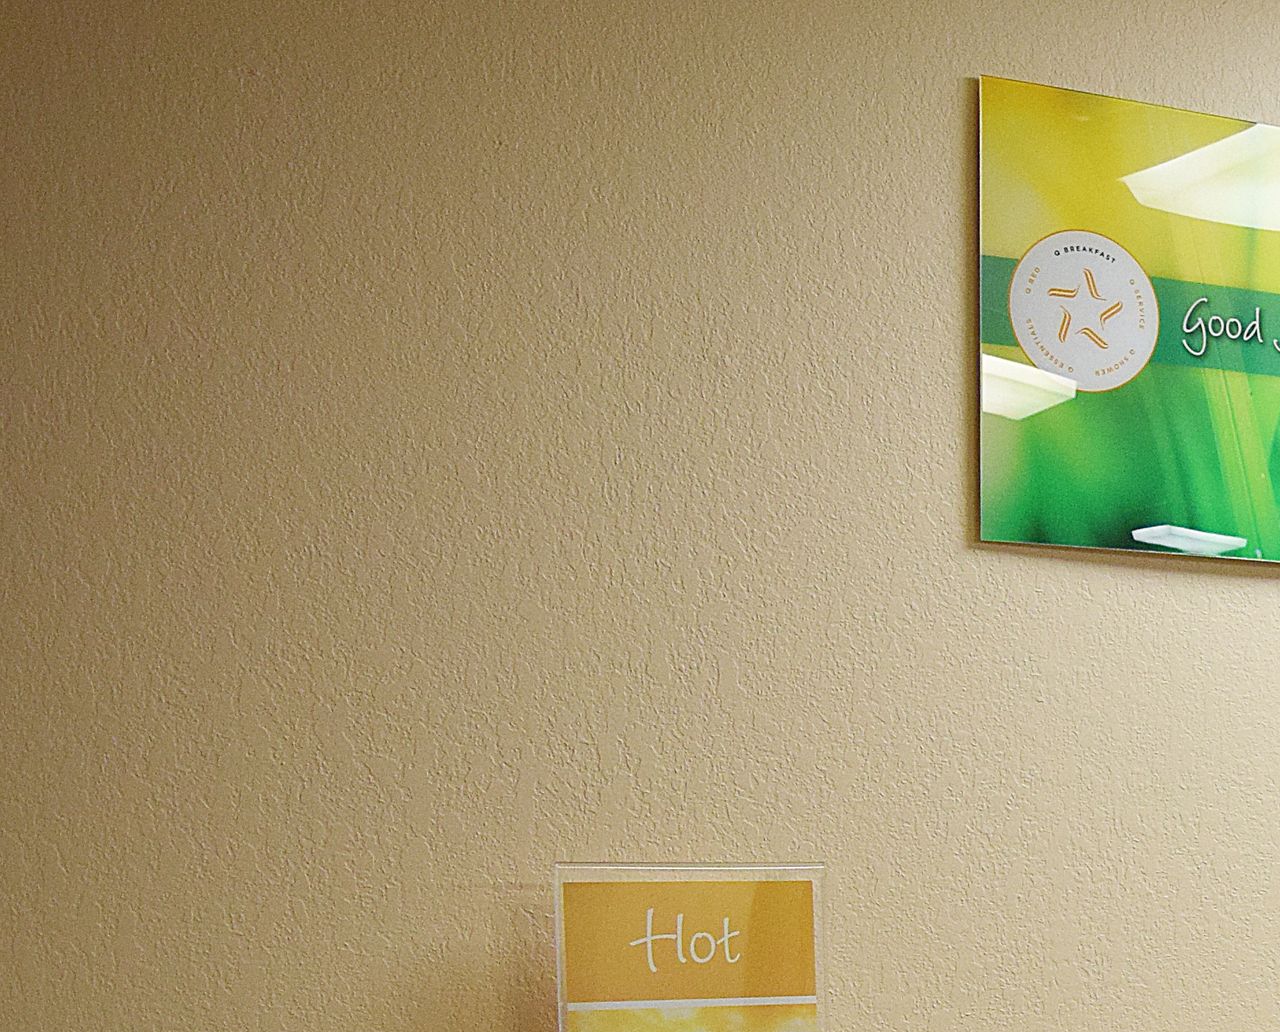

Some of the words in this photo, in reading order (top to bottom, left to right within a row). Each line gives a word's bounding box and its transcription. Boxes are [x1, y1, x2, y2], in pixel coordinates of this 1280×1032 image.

[1028, 266, 1041, 284] BED
[1054, 249, 1061, 257] Q
[1063, 245, 1116, 264] BREAKFAST
[1134, 289, 1146, 330] SERVICE
[1182, 297, 1264, 357] Good
[1026, 318, 1065, 369] ESSENTIALS
[1095, 356, 1129, 377] SHOWER
[629, 908, 740, 973] Hot
